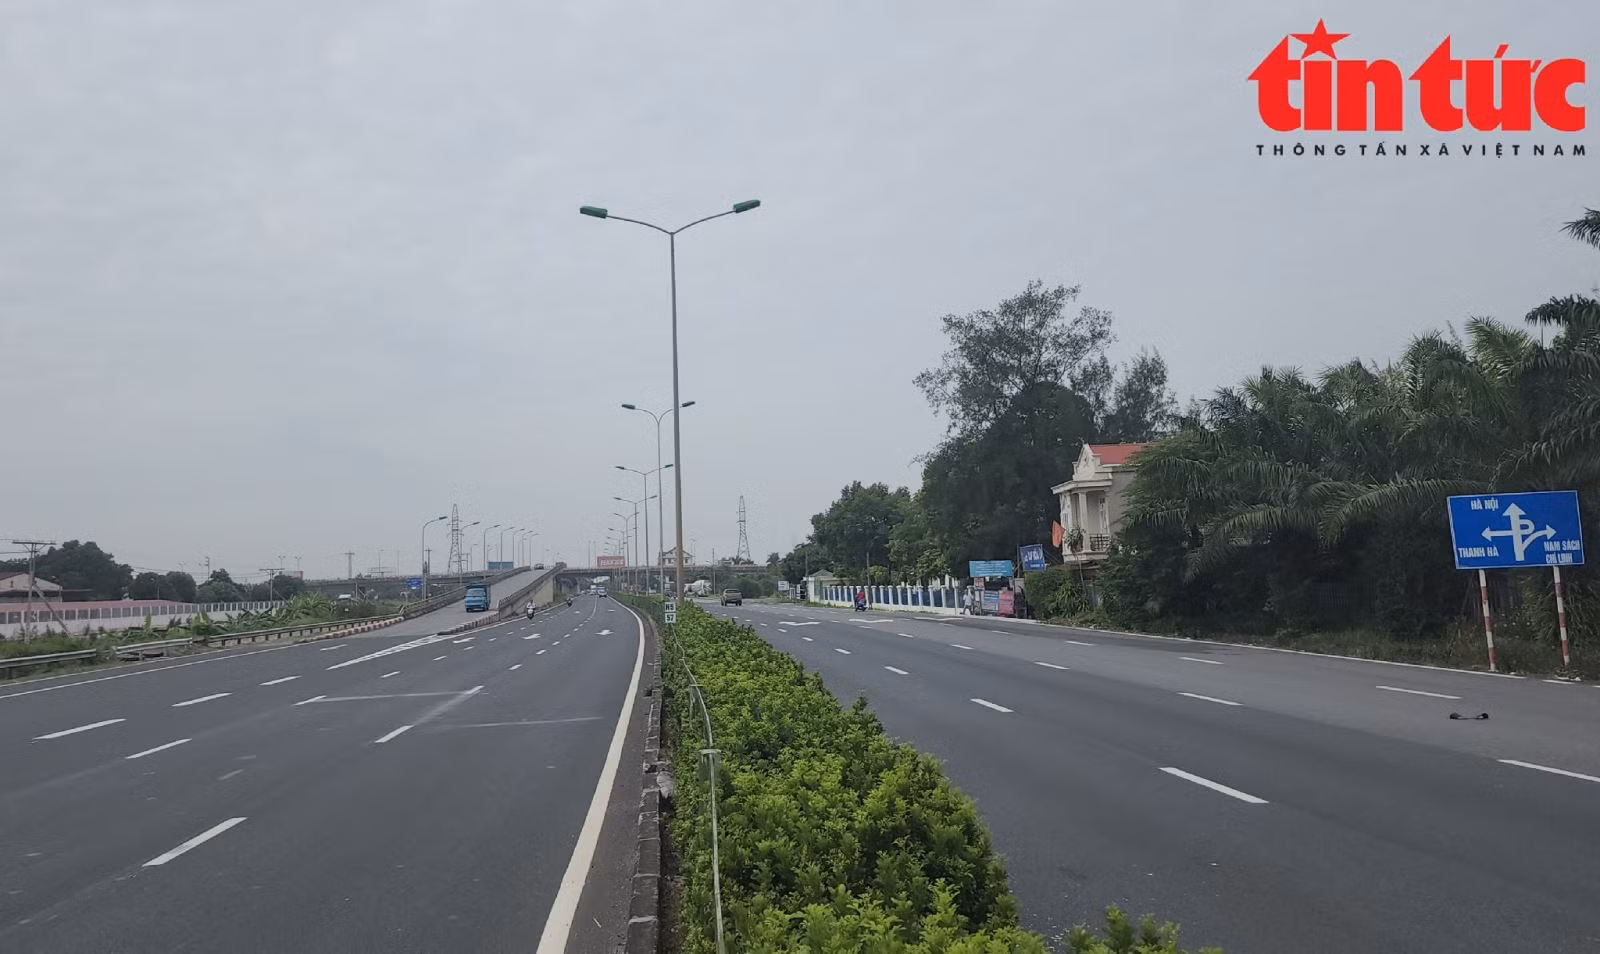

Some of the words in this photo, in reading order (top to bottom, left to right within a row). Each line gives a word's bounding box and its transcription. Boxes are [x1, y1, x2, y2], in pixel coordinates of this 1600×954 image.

[1470, 498, 1483, 510] HÀ
[1484, 497, 1498, 511] NỘI
[1457, 547, 1486, 558] THANH
[1486, 544, 1499, 557] HÀ
[1543, 540, 1561, 552] NAM
[1561, 538, 1580, 551] SÁCH
[666, 614, 674, 622] 57
